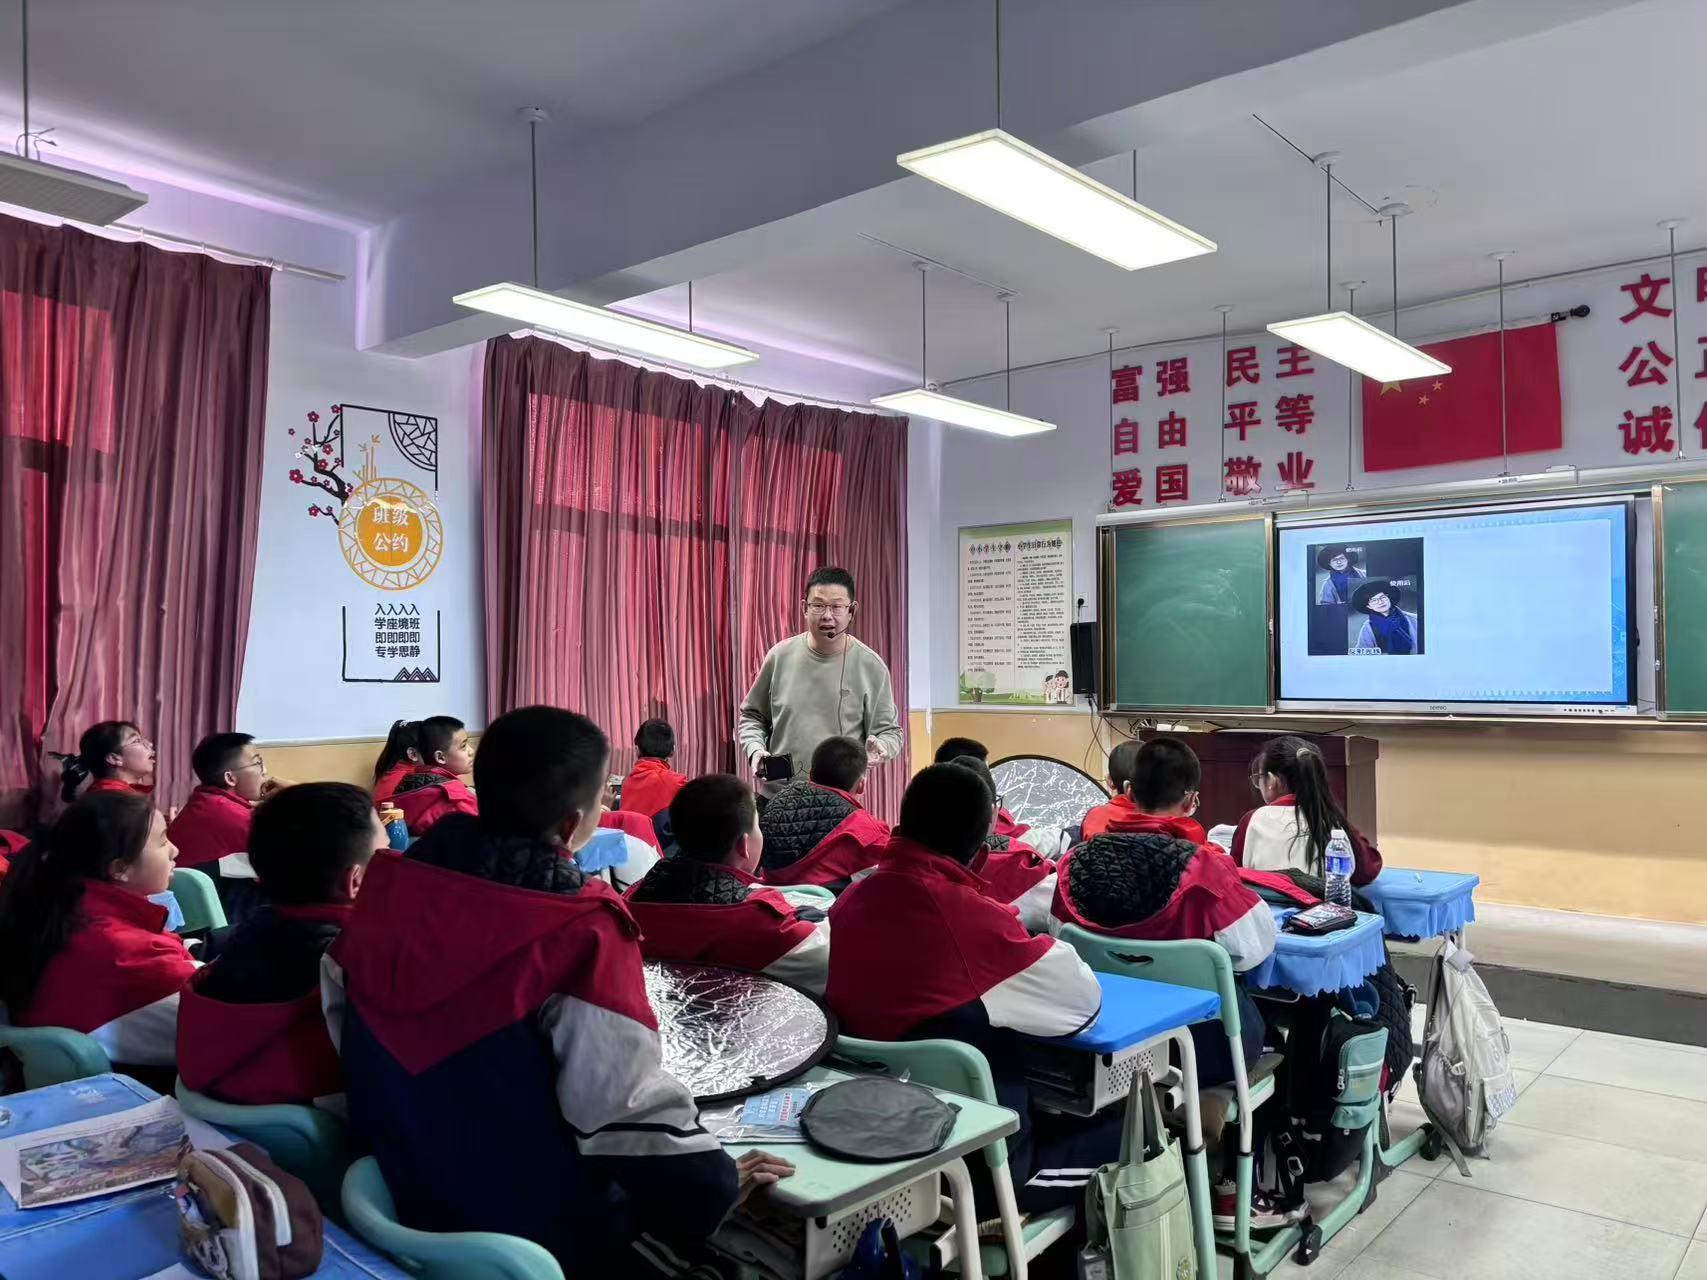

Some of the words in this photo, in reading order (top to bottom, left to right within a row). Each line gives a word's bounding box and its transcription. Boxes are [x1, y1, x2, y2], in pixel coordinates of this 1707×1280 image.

[1111, 357, 1191, 404] 富强
[1114, 411, 1187, 456] 自由
[1224, 394, 1314, 441] 平等
[1112, 463, 1188, 507] 爱国
[1224, 451, 1315, 496] 敬业
[372, 532, 409, 553] 公约
